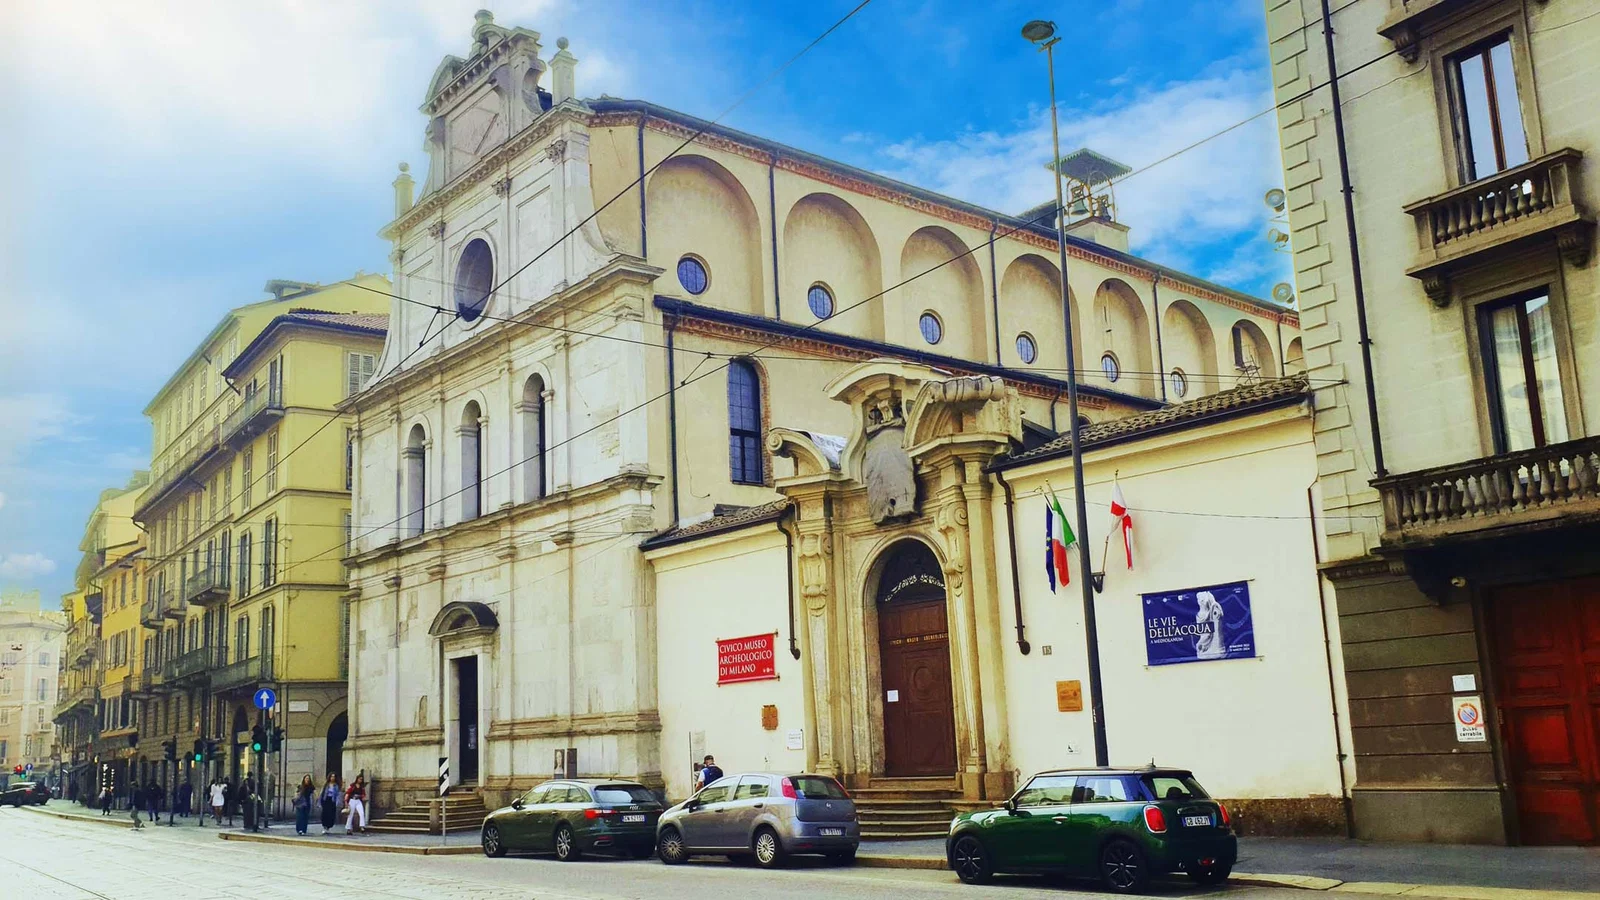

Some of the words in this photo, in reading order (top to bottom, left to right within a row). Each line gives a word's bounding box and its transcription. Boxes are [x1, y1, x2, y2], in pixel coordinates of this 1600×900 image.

[1148, 618, 1158, 628] LE
[1160, 616, 1177, 626] VIE
[1149, 623, 1211, 639] DELL'ACQUA
[720, 643, 743, 653] CIVICO
[744, 639, 767, 650] MUSEO
[720, 650, 772, 664] ARCHEOLOGICO
[720, 667, 728, 676] DI
[729, 663, 756, 675] MILANO
